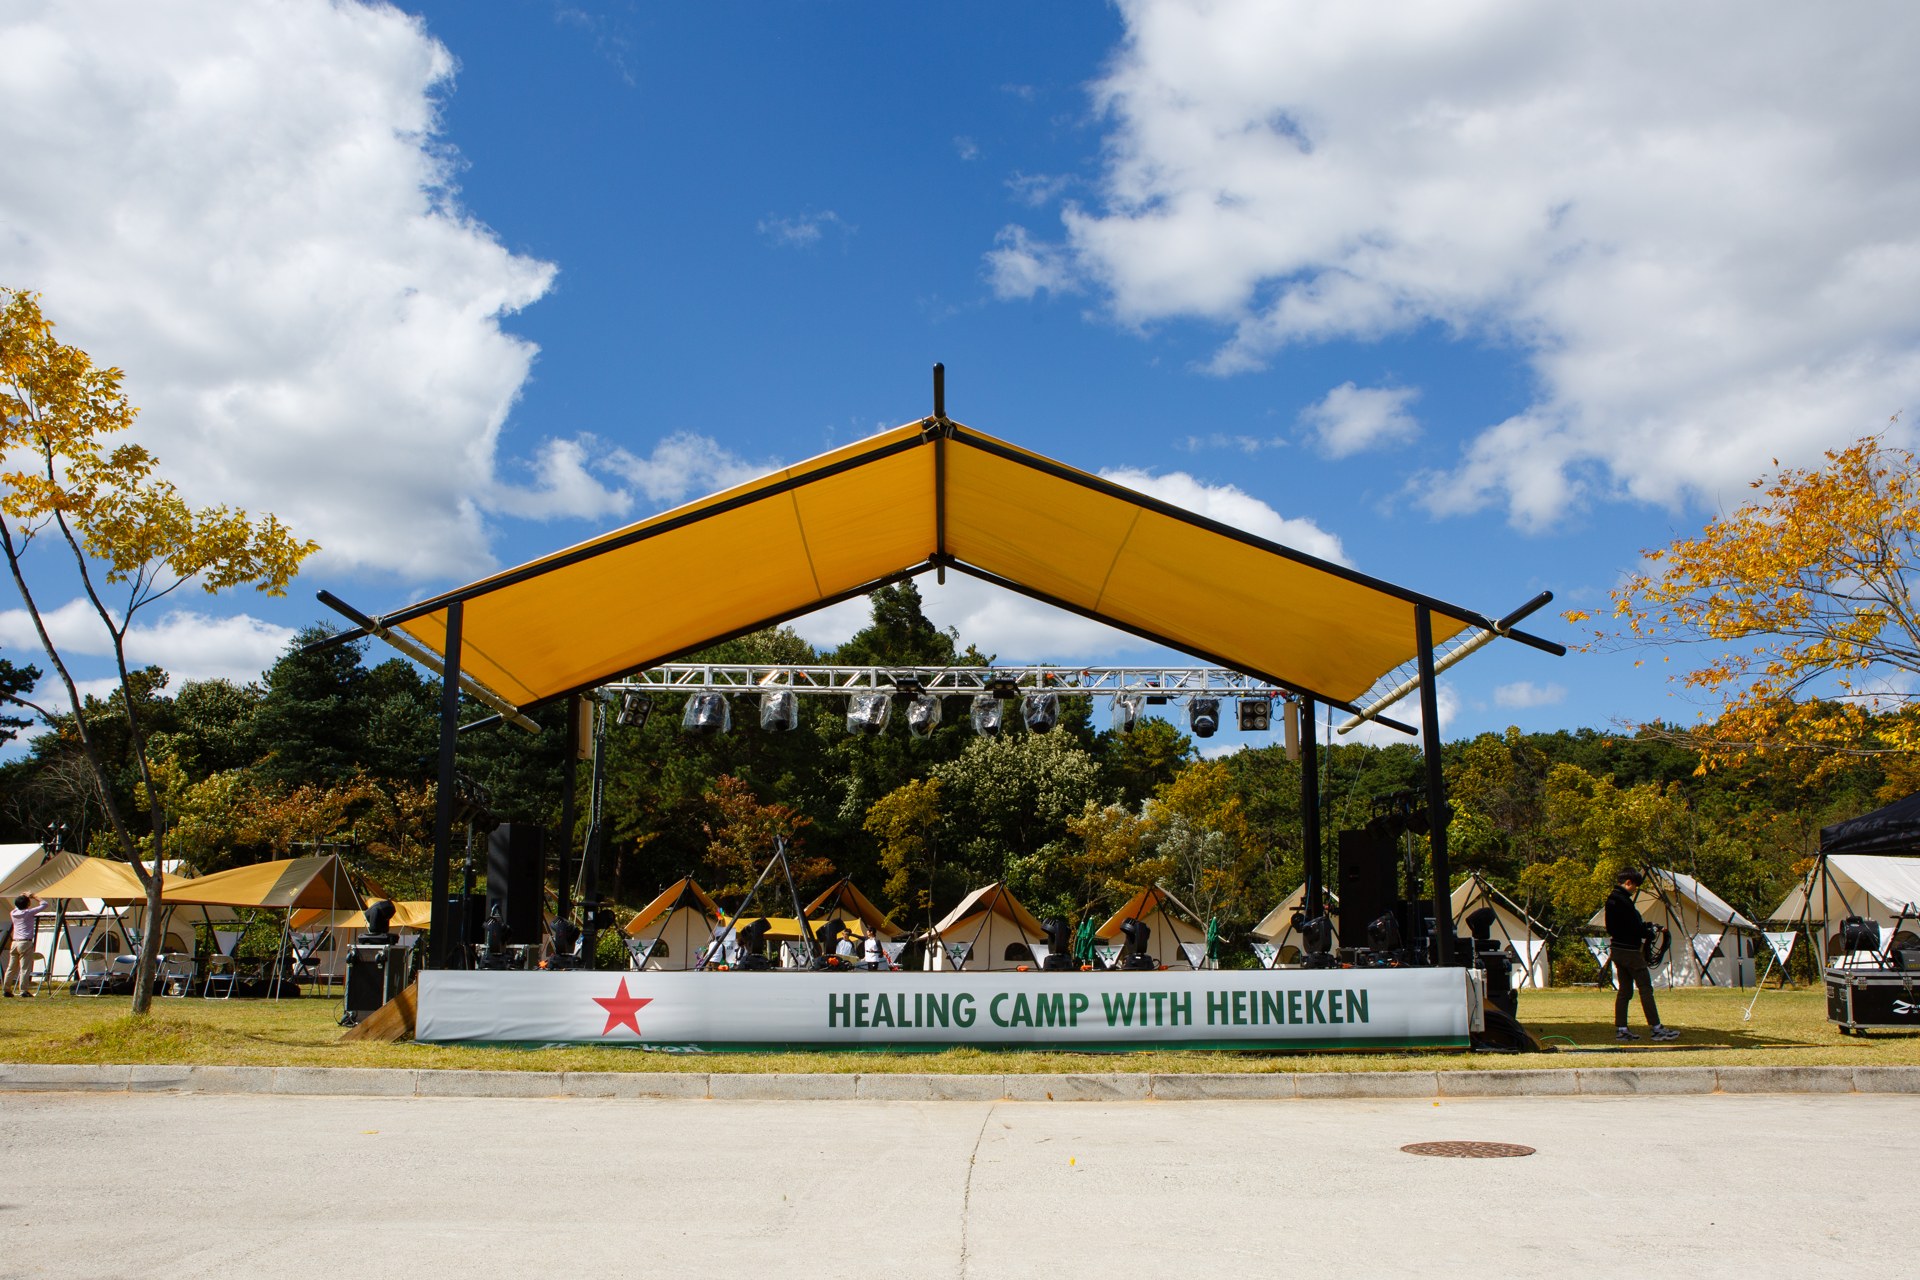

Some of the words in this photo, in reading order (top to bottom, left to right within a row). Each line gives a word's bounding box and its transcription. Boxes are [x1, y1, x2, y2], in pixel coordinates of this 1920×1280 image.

[828, 992, 977, 1028] HEALING
[989, 992, 1089, 1028] CAMP
[1101, 991, 1192, 1027] WITH
[1206, 989, 1369, 1025] HEINEKEN
